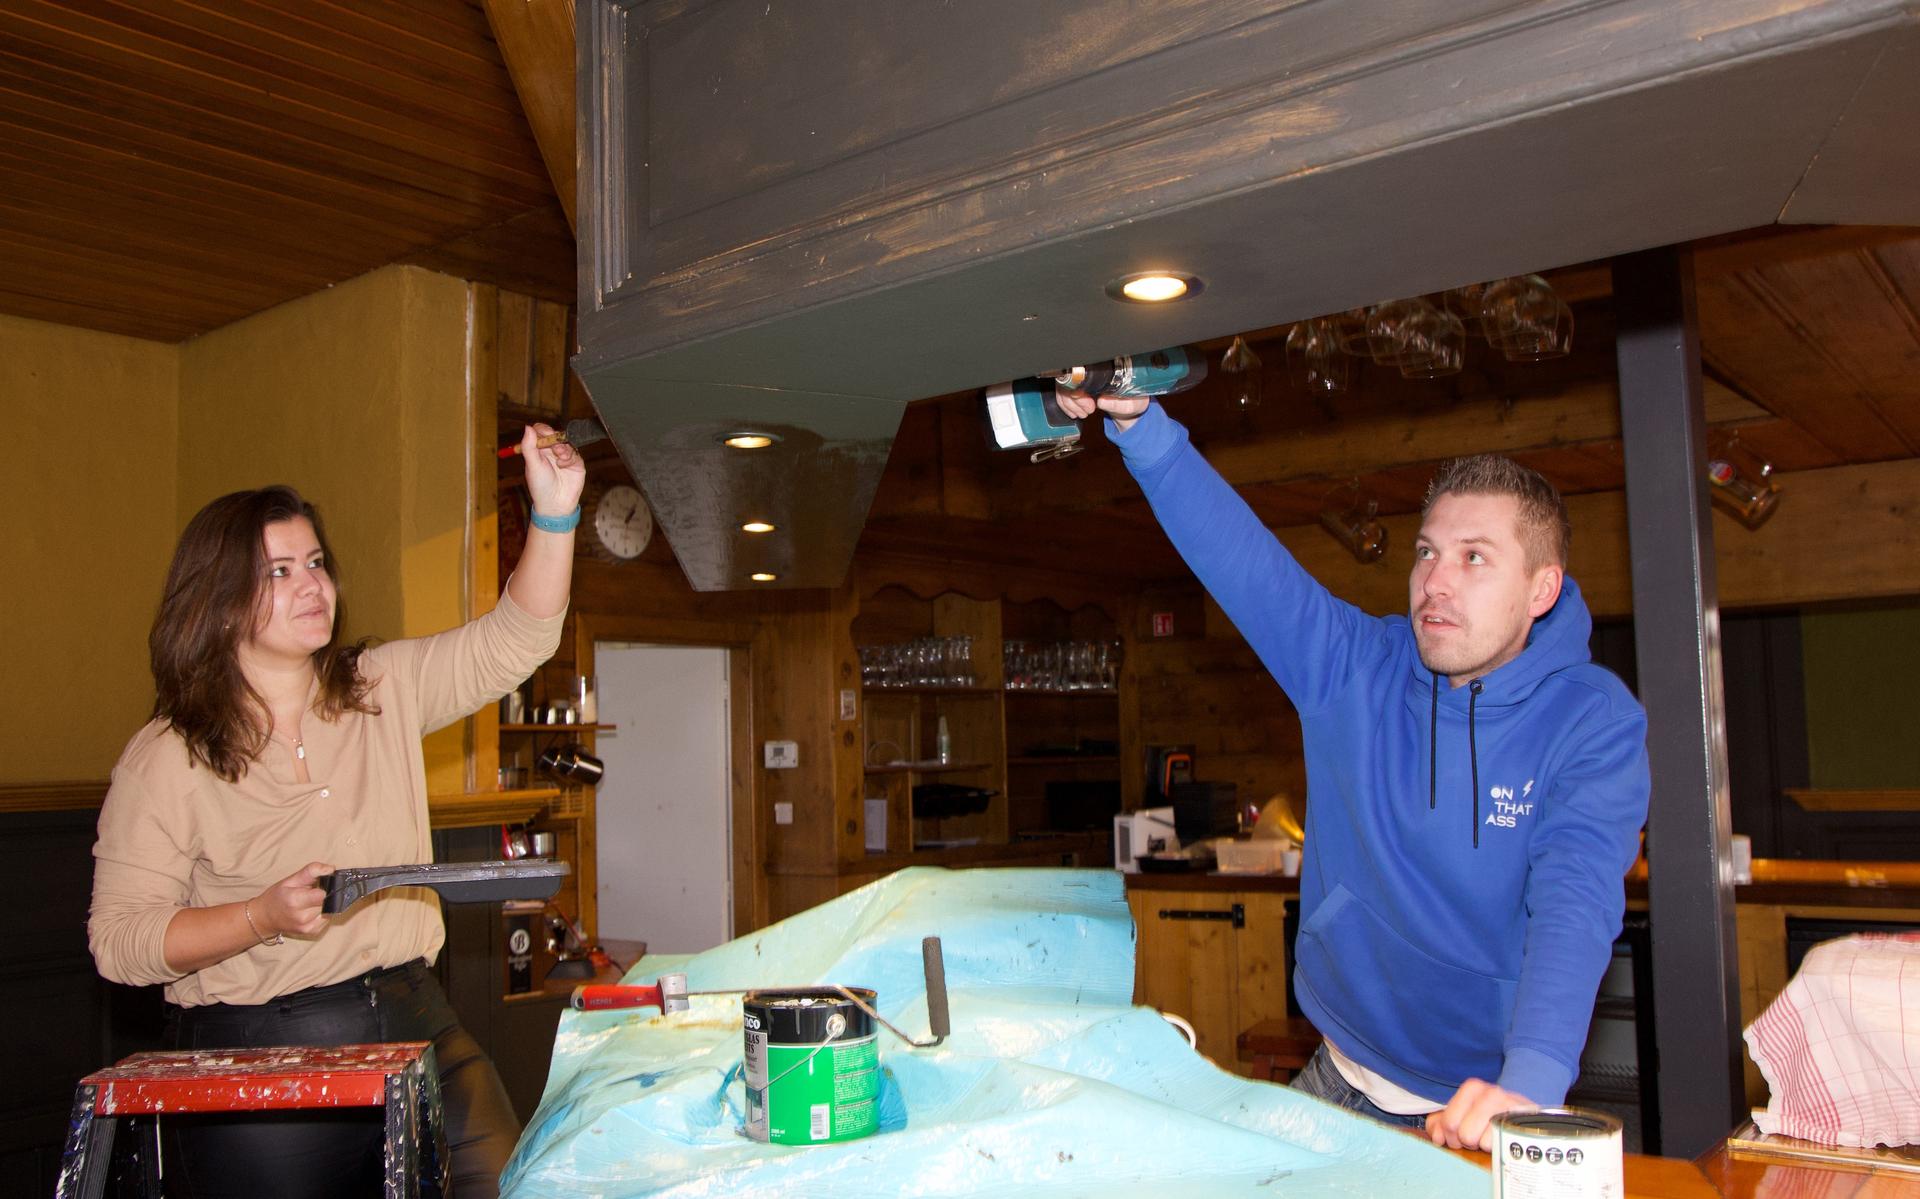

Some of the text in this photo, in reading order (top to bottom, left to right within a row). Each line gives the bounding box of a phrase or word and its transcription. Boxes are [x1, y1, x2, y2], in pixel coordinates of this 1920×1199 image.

[1490, 787, 1513, 800] ON
[1494, 801, 1533, 816] THAT
[1485, 813, 1516, 828] ASS
